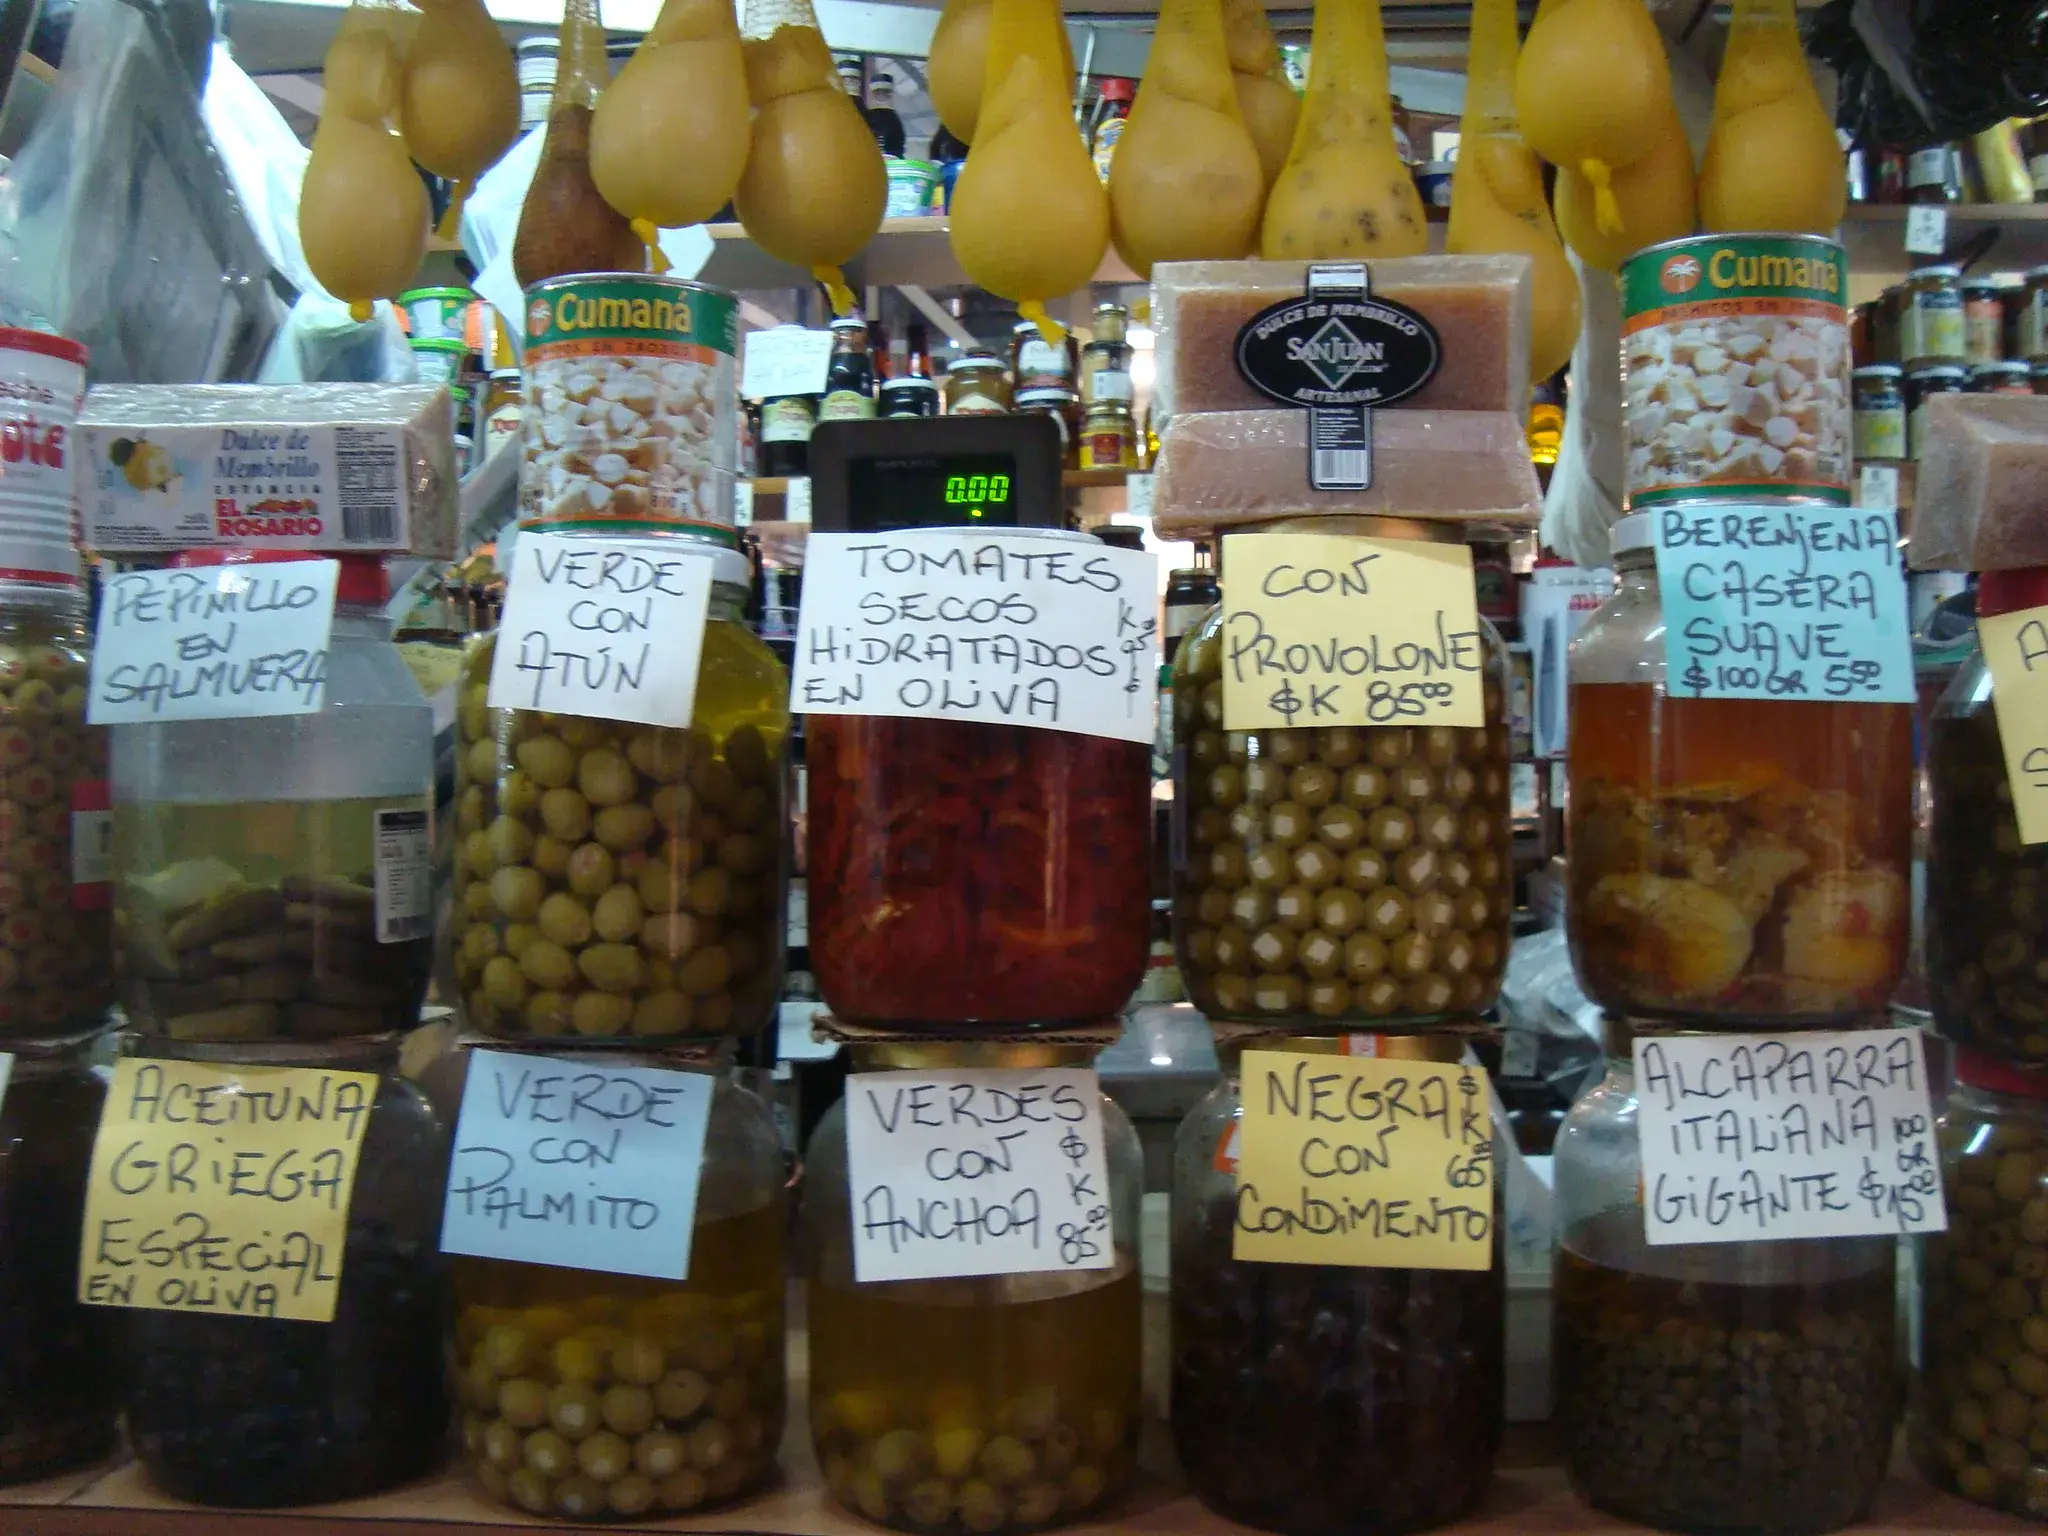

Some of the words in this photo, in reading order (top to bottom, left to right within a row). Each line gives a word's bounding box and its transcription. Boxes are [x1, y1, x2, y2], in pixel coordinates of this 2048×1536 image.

[1709, 248, 1838, 293] Cumaná
[556, 290, 692, 333] Cumaná
[221, 428, 280, 450] Dulce
[285, 428, 310, 450] de
[213, 456, 320, 477] Membrillo
[215, 499, 241, 517] EL
[216, 517, 324, 536] ROSARIO
[534, 549, 685, 597] VERDE
[845, 544, 1121, 593] TOMATES
[1262, 554, 1380, 597] CON
[1683, 561, 1876, 619] CASERA
[568, 597, 652, 633] CON
[858, 591, 1037, 625] SECOS
[176, 623, 236, 661] EN
[1228, 610, 1481, 682] PROVOLONE
[1683, 617, 1849, 662] SUAVE
[102, 650, 328, 712] SALMUERA
[515, 631, 650, 707] ATÚN
[803, 673, 863, 706] EN
[1640, 1037, 1914, 1110] ALCAPARRA
[495, 1070, 685, 1128] VERDE
[867, 1083, 1087, 1133] VERDES
[1267, 1061, 1451, 1139] NEGRA
[529, 1128, 624, 1169] CON
[926, 1130, 1028, 1181] CON
[1300, 1124, 1400, 1178] CON
[863, 1184, 1040, 1254] ANCHOA
[86, 1272, 136, 1303] EN
